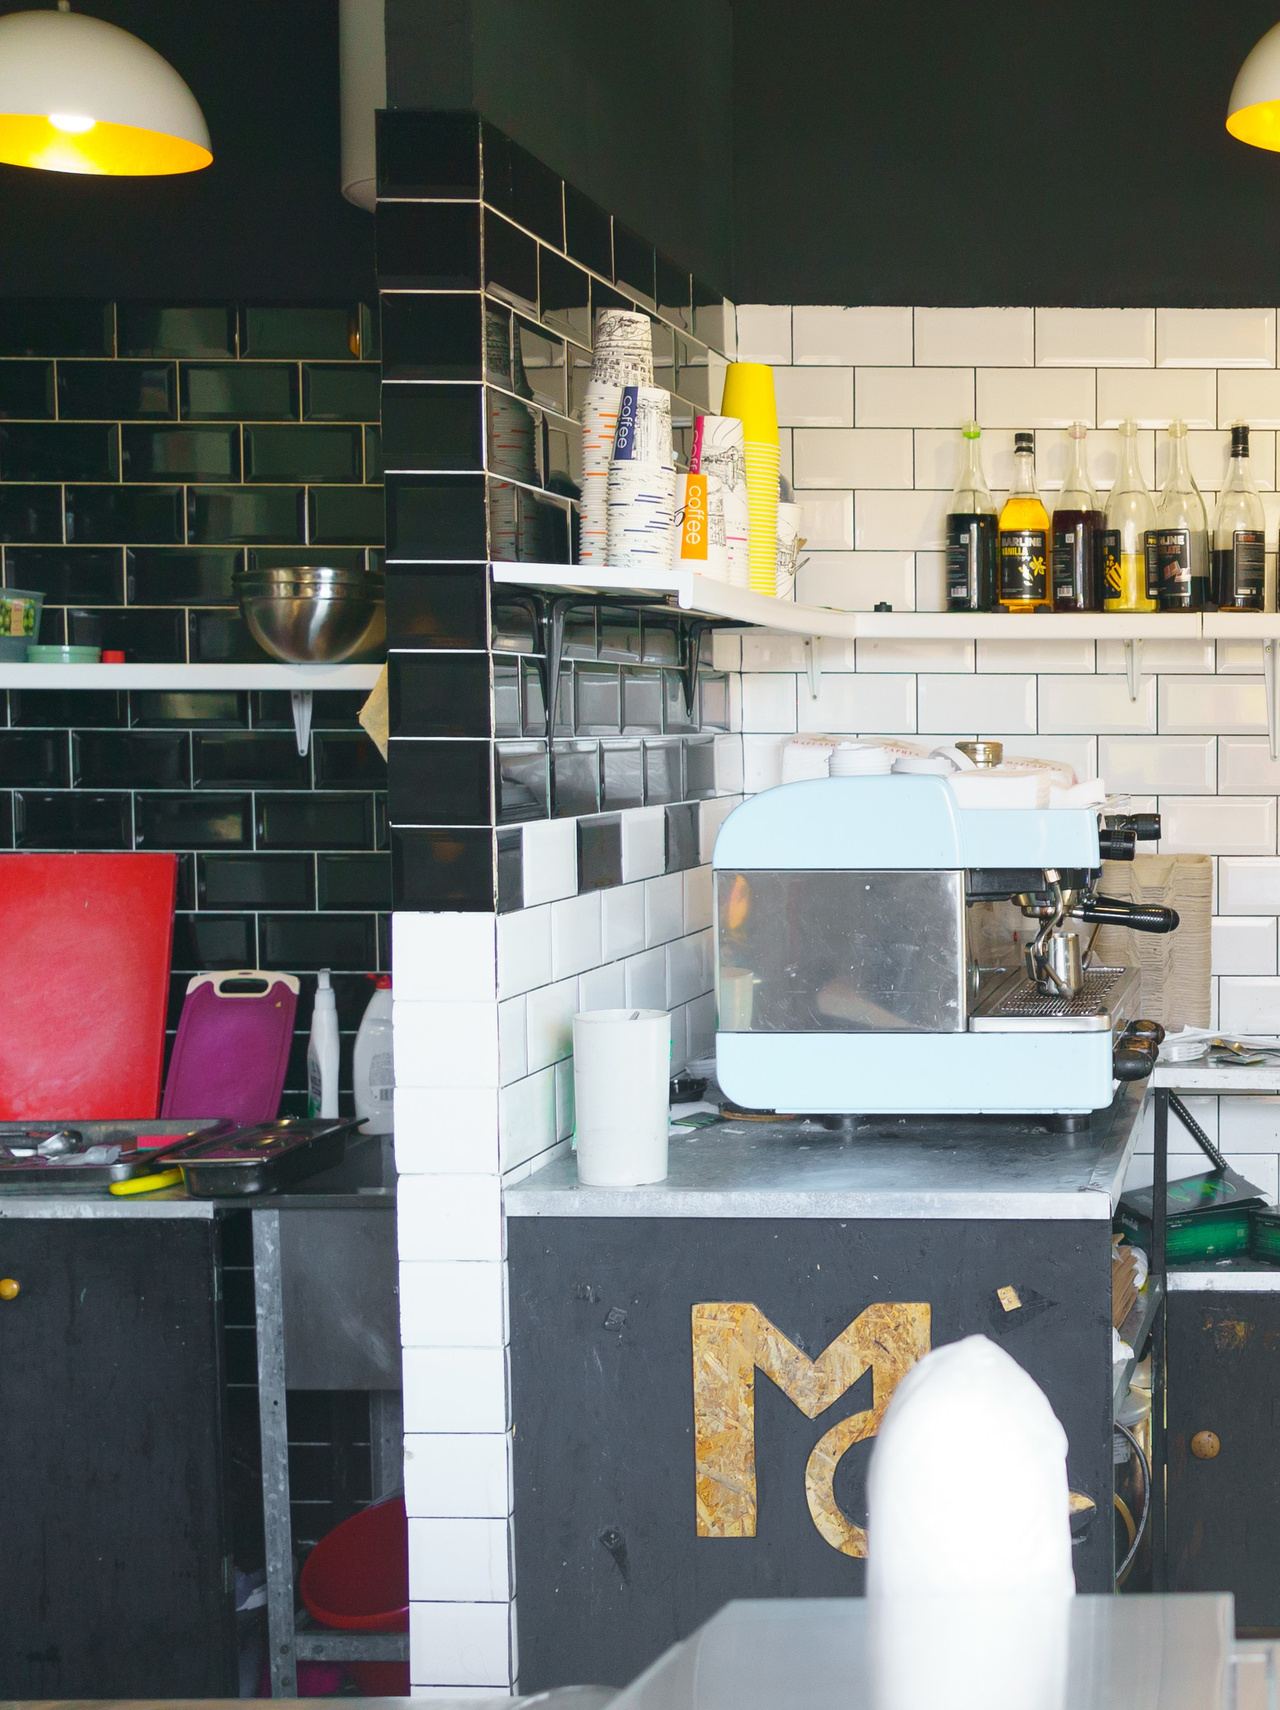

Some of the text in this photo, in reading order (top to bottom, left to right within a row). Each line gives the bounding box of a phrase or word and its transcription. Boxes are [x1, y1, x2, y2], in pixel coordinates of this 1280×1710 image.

[617, 395, 633, 449] coffee
[690, 430, 699, 474] coff
[685, 485, 705, 545] coffee
[1001, 536, 1043, 547] BARLINE
